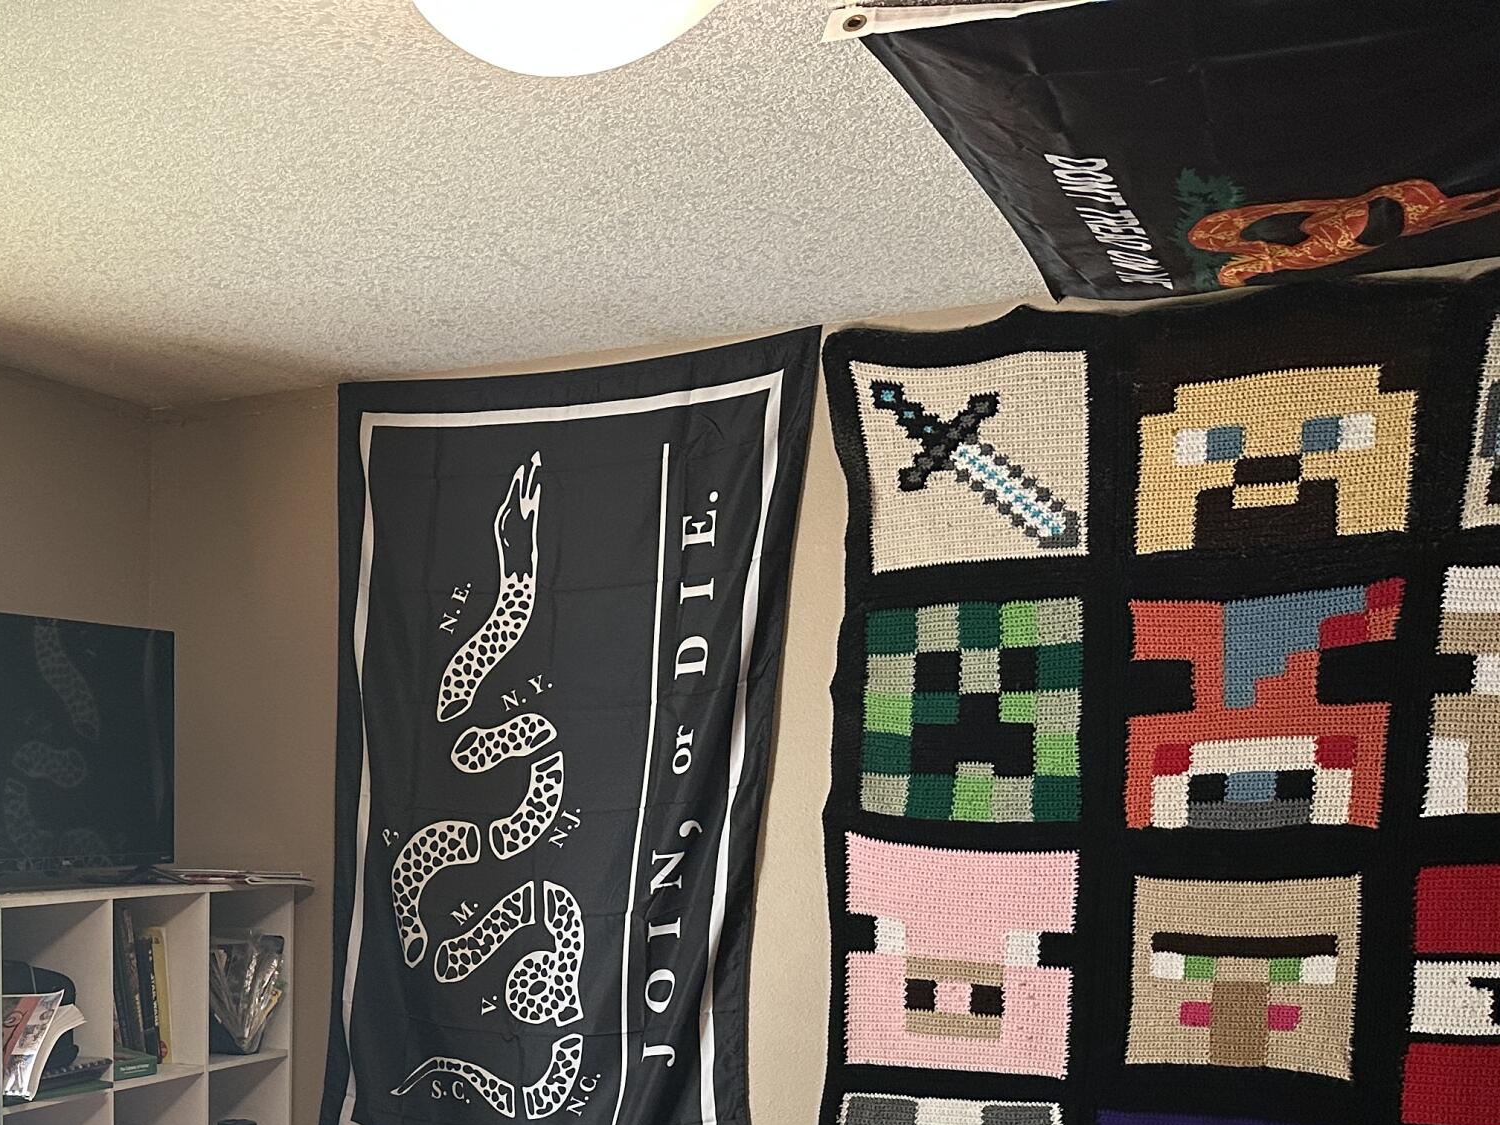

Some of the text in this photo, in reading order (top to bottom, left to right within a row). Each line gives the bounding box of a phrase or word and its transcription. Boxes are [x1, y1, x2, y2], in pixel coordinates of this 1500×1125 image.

[1044, 154, 1127, 206] DONT
[1076, 207, 1152, 251] TREAD
[1107, 250, 1163, 273] ON
[642, 491, 719, 1067] JOIN, or DIE.
[451, 901, 479, 926] M.
[481, 995, 498, 1016] V.
